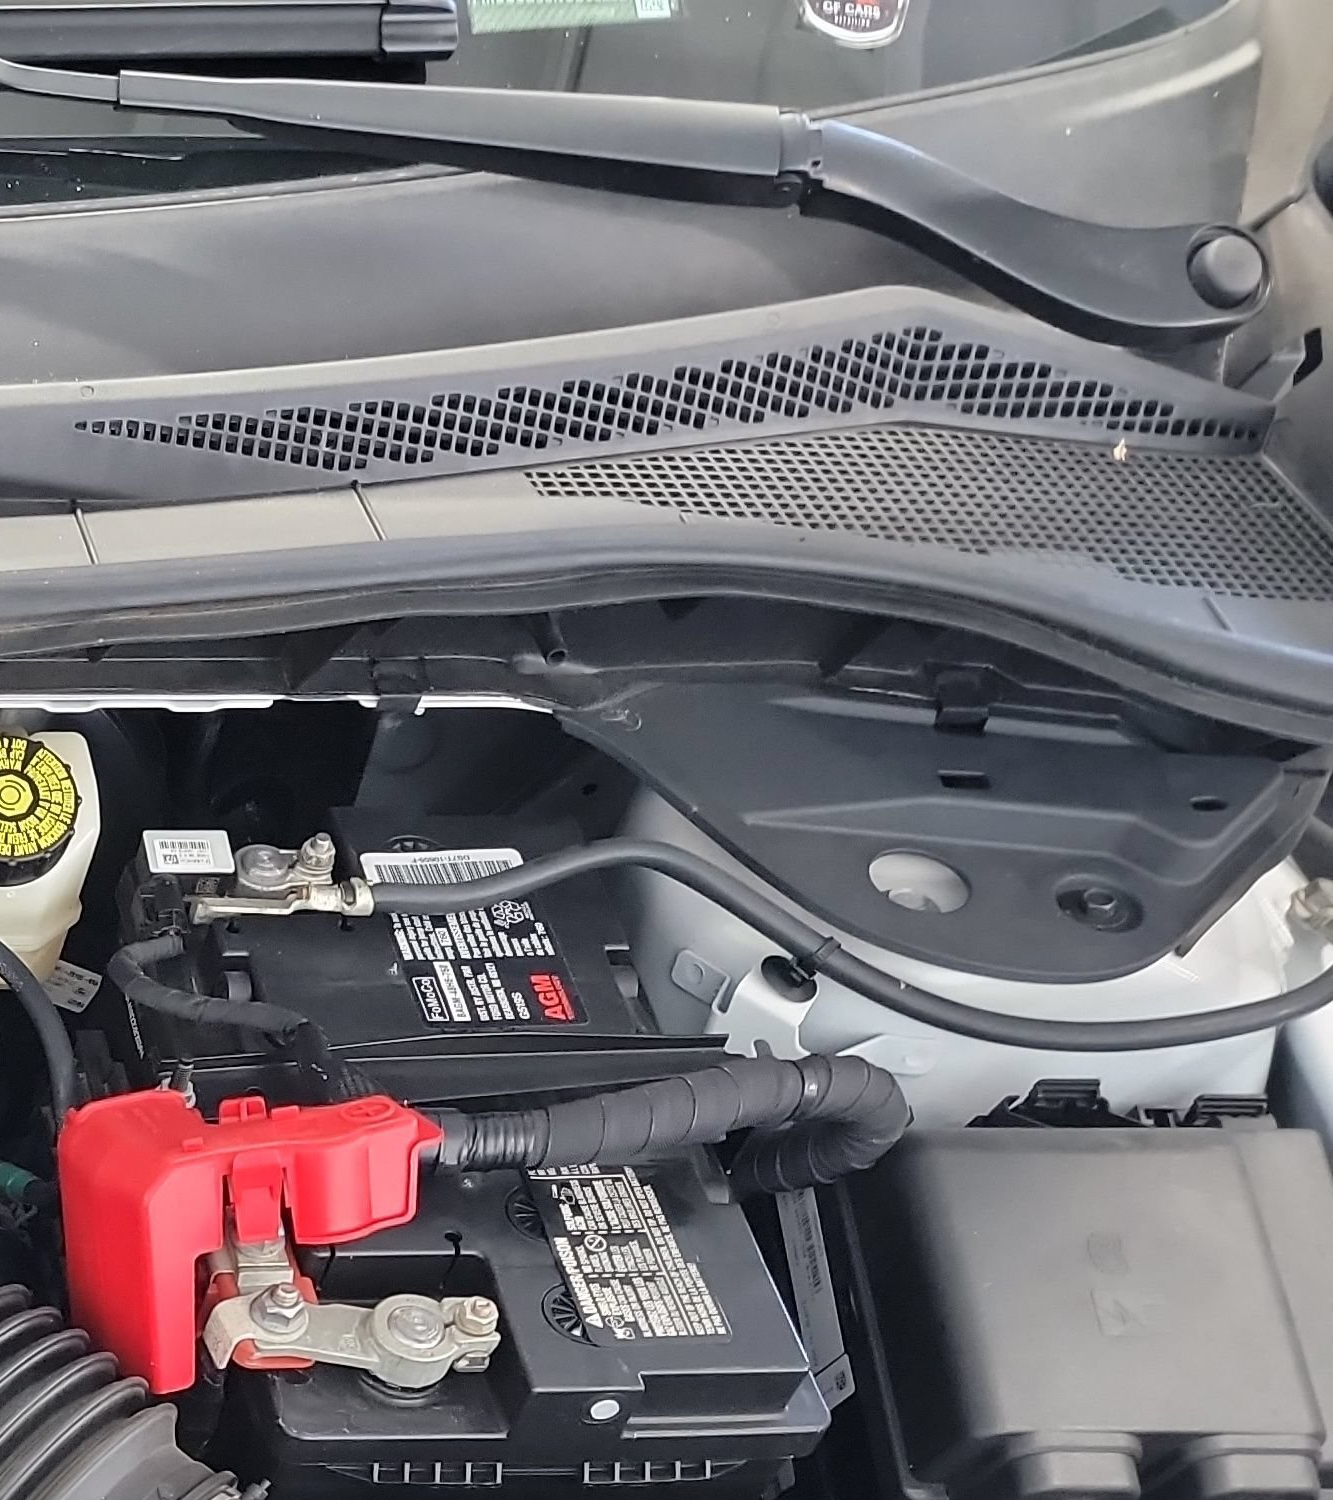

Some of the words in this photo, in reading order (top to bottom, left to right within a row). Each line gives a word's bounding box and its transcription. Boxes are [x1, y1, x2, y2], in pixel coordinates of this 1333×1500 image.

[12, 738, 27, 749] DOT
[420, 978, 444, 1020] FoMoCo
[530, 974, 566, 1020] AGM
